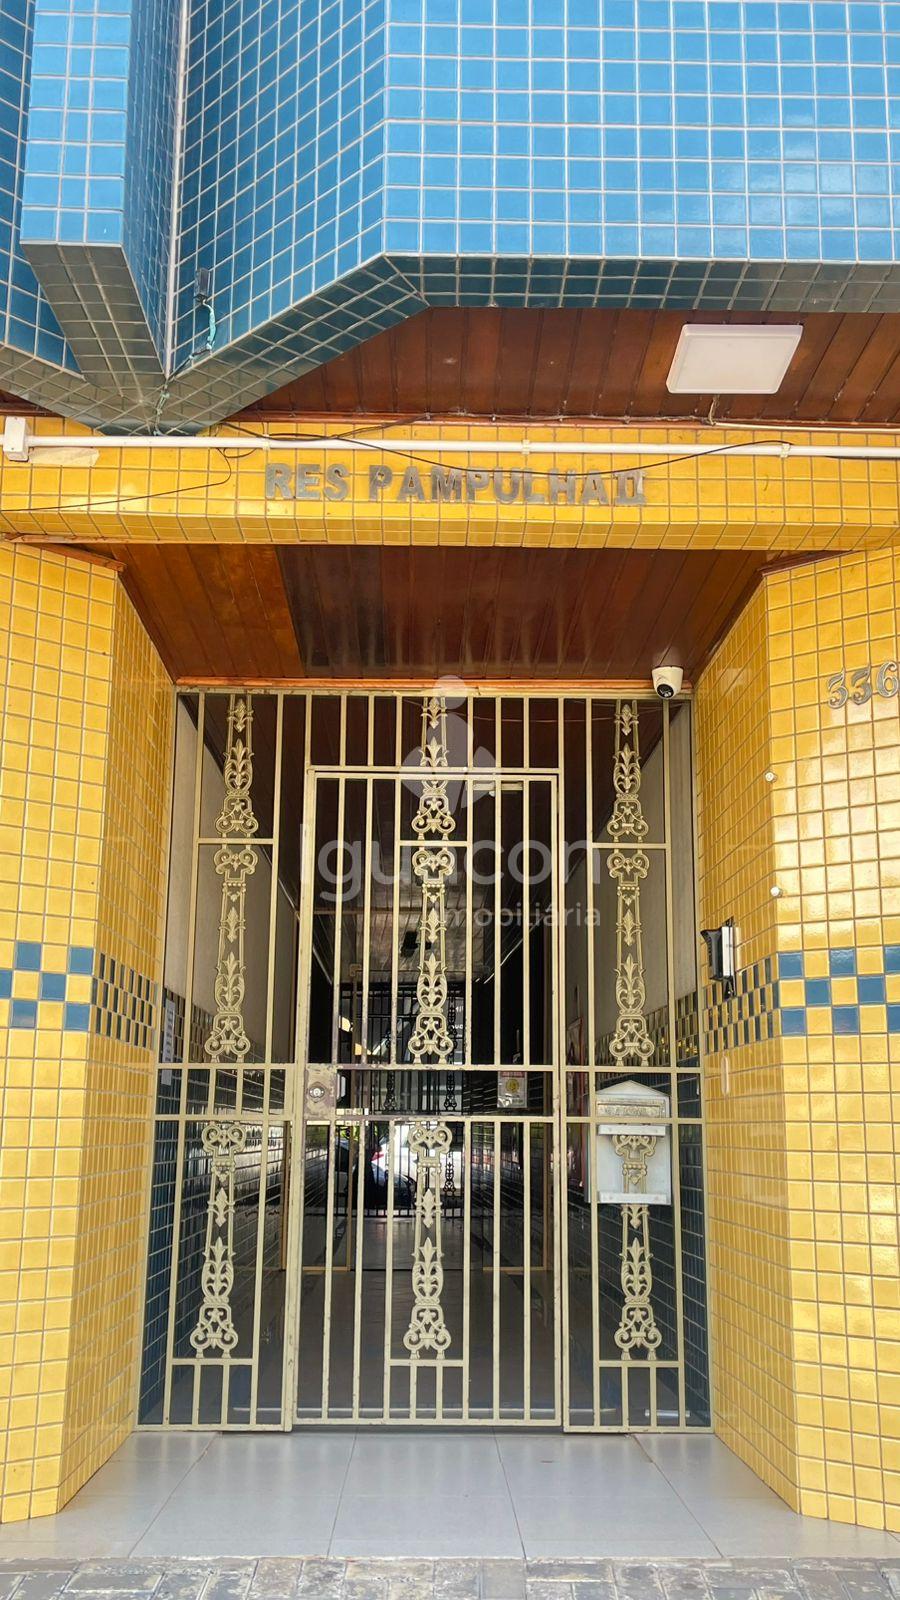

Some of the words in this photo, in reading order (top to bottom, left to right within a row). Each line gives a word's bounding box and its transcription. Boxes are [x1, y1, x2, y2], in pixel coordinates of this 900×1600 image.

[265, 463, 350, 501] RES
[368, 464, 610, 505] PAMPULHA
[827, 660, 899, 709] 336
